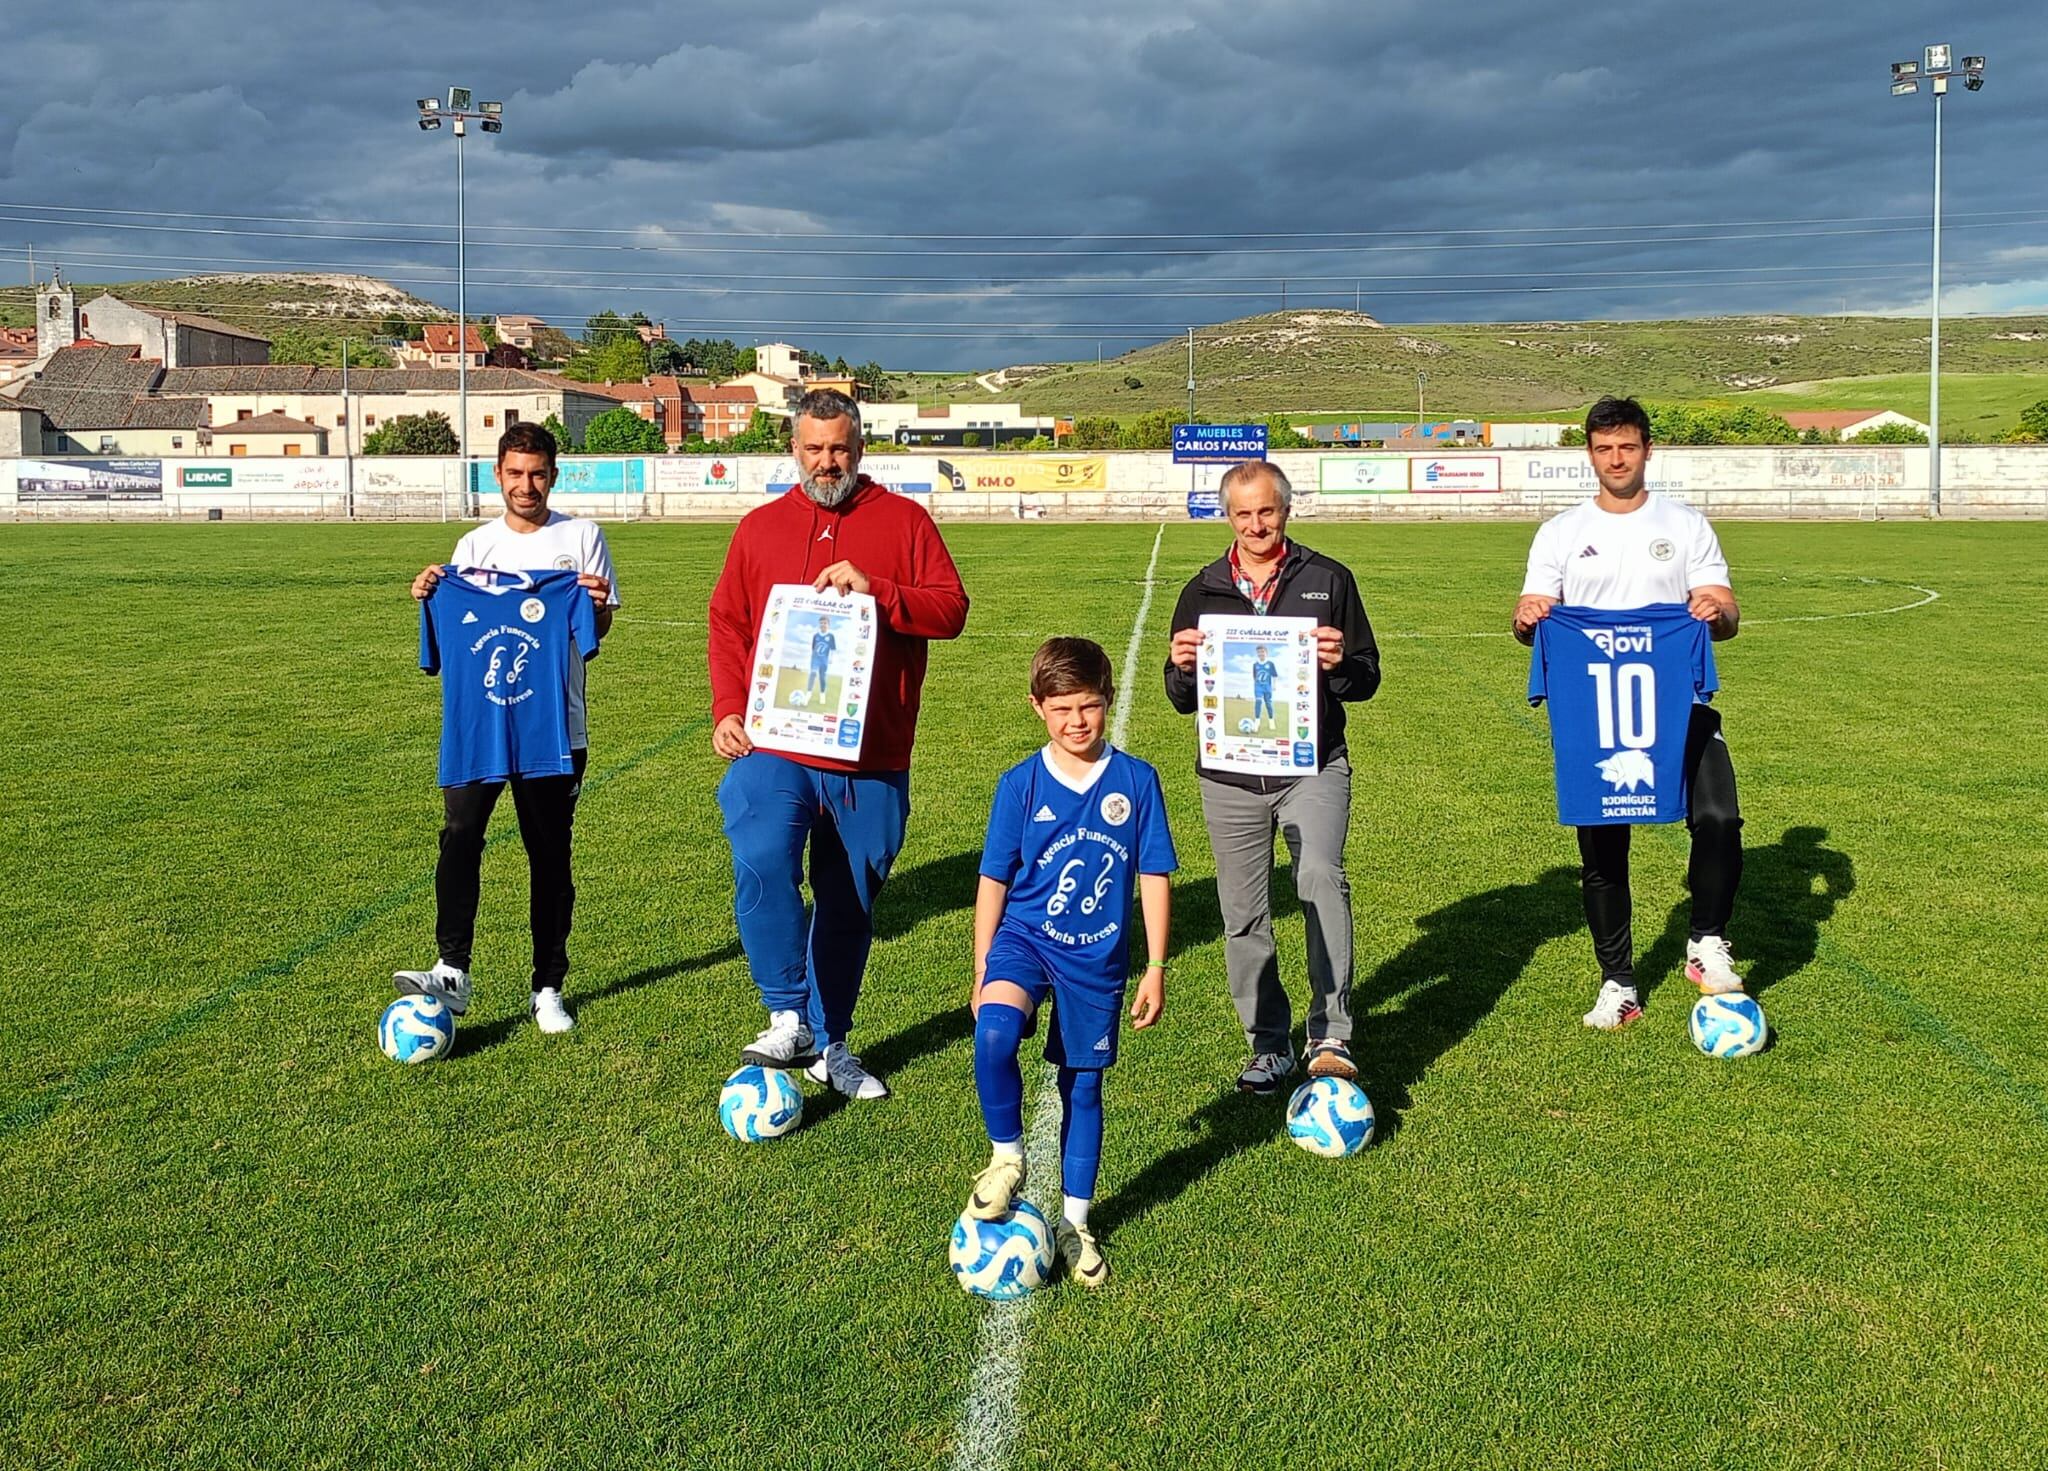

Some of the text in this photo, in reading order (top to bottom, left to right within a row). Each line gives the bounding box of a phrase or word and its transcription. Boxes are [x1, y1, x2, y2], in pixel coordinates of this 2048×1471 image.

[1197, 428, 1243, 438] MUEBLES
[1175, 440, 1264, 451] CARLOS PASTOR
[185, 473, 227, 482] UEMC
[1528, 460, 1595, 479] Carch
[1614, 625, 1652, 633] Ventanas
[500, 625, 541, 650] Funeraria
[1591, 632, 1653, 653] Govi
[507, 688, 534, 705] Teresa
[1587, 662, 1656, 749] 10
[1602, 793, 1656, 806] RODRÍGUEZ
[1602, 805, 1656, 818] SACRISTÁN
[1037, 827, 1129, 869] Agencia Funeraria
[1041, 920, 1119, 945] Santa Teresa
[442, 976, 458, 992] N
